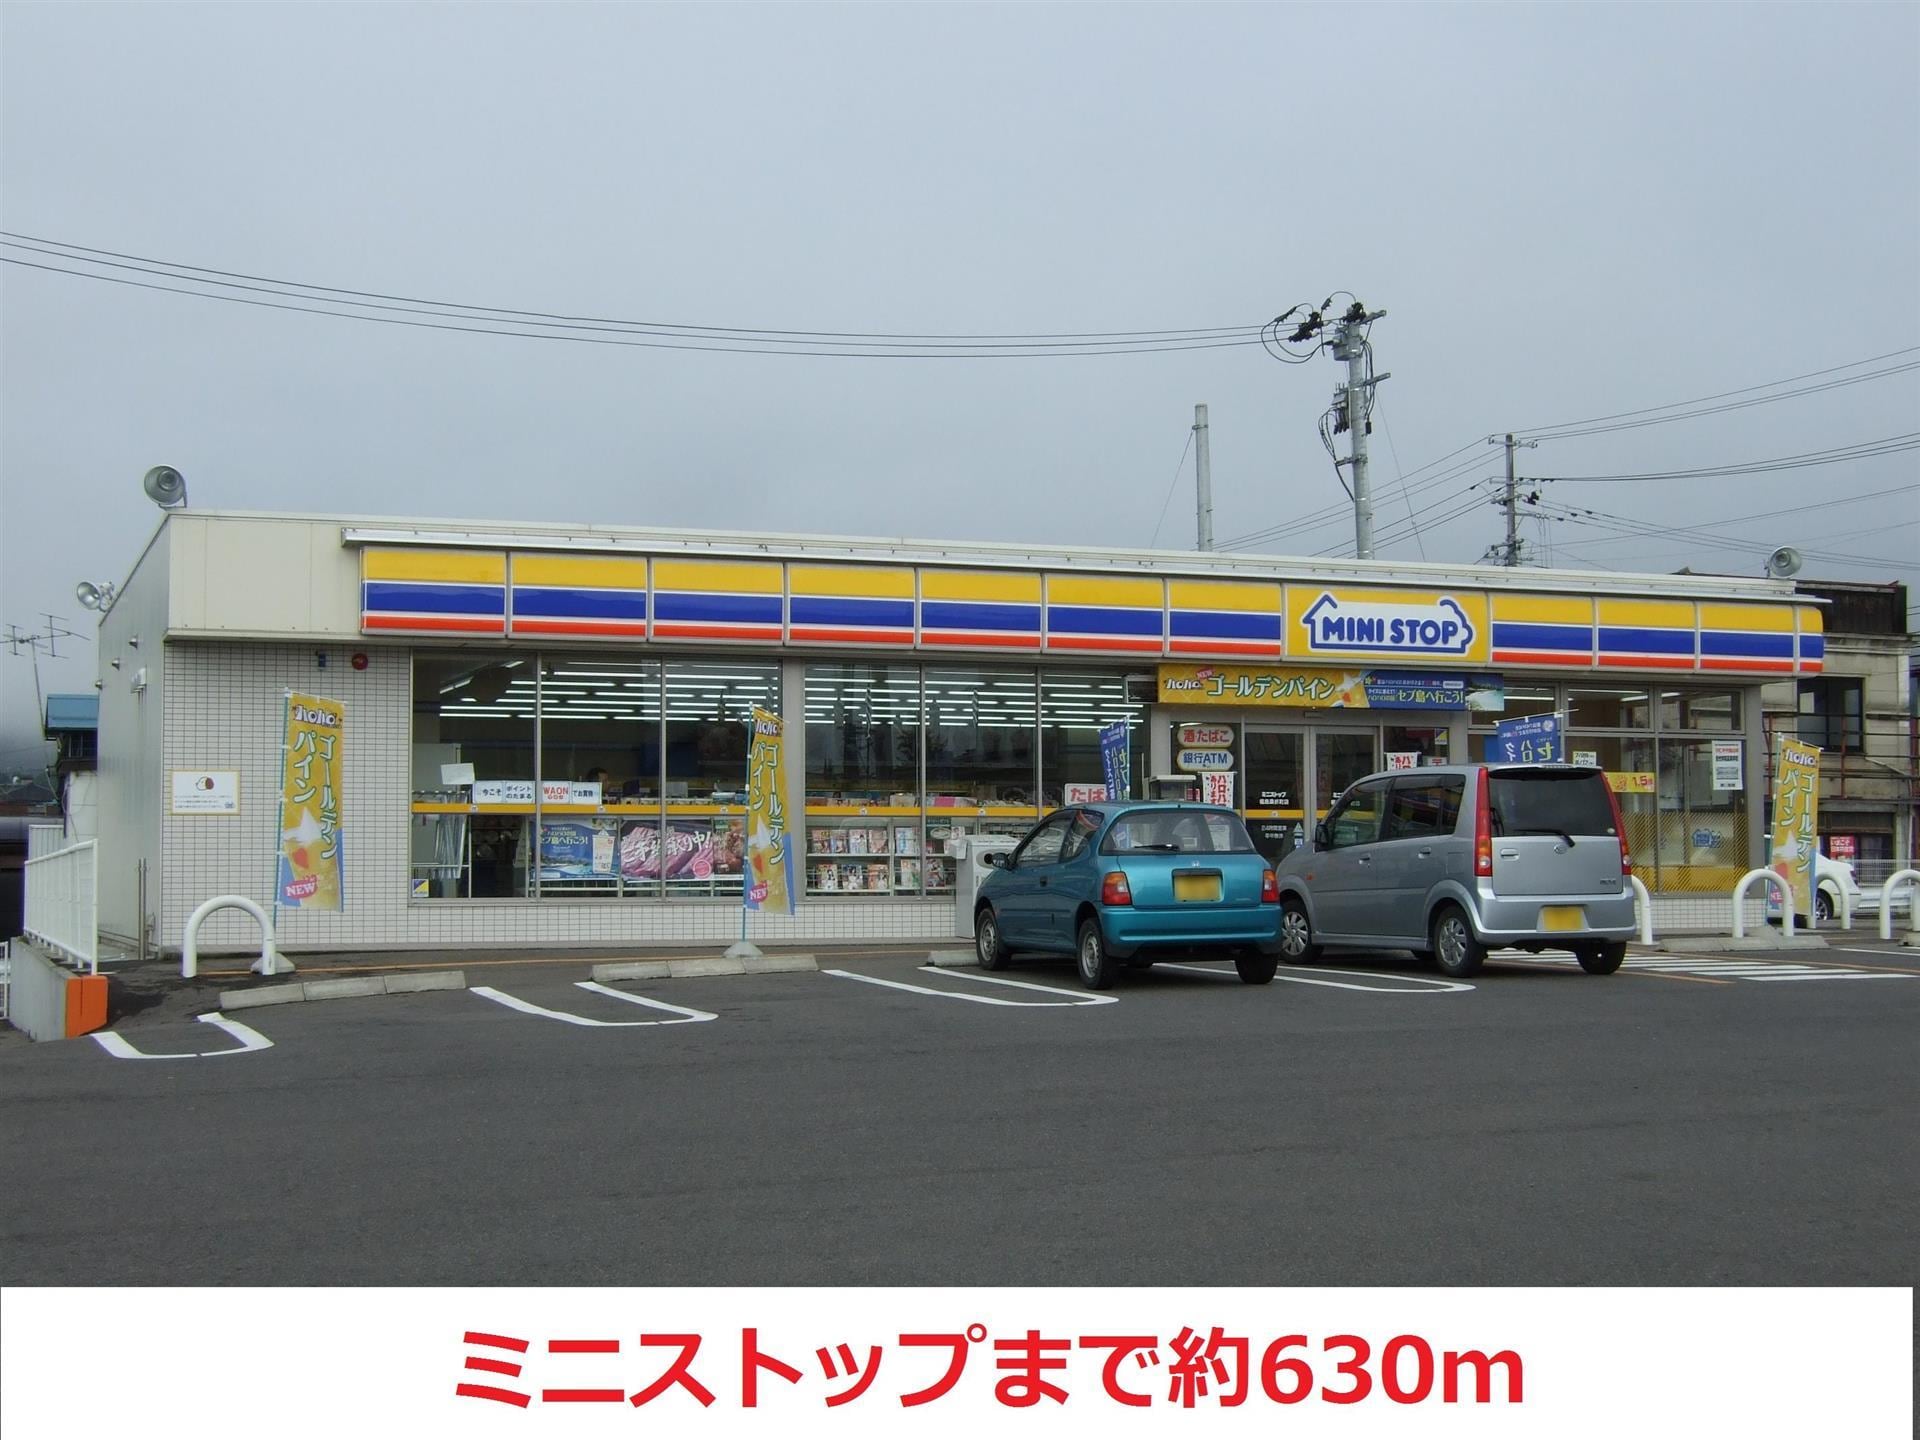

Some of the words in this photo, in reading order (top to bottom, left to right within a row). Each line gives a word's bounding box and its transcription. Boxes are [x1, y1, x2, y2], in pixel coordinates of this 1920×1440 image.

[1323, 616, 1384, 642] MINI
[1390, 618, 1459, 646] STOP
[1207, 674, 1336, 700] ゴールデンパイン
[1398, 689, 1464, 704] セブ島へ行こう!
[293, 730, 317, 804] パイン
[1183, 753, 1228, 764] 銀行ATM
[753, 741, 766, 811] パイン
[320, 734, 337, 860] ゴールデン
[482, 788, 502, 796] 今こそ
[543, 786, 568, 795] WAON
[1071, 787, 1106, 802] たば
[1780, 768, 1800, 827] パイン
[766, 743, 785, 865] ゴールデン
[1796, 773, 1815, 873] ゴールデン
[286, 882, 317, 898] NEW
[749, 888, 768, 901] NEW
[1771, 891, 1783, 901] NE
